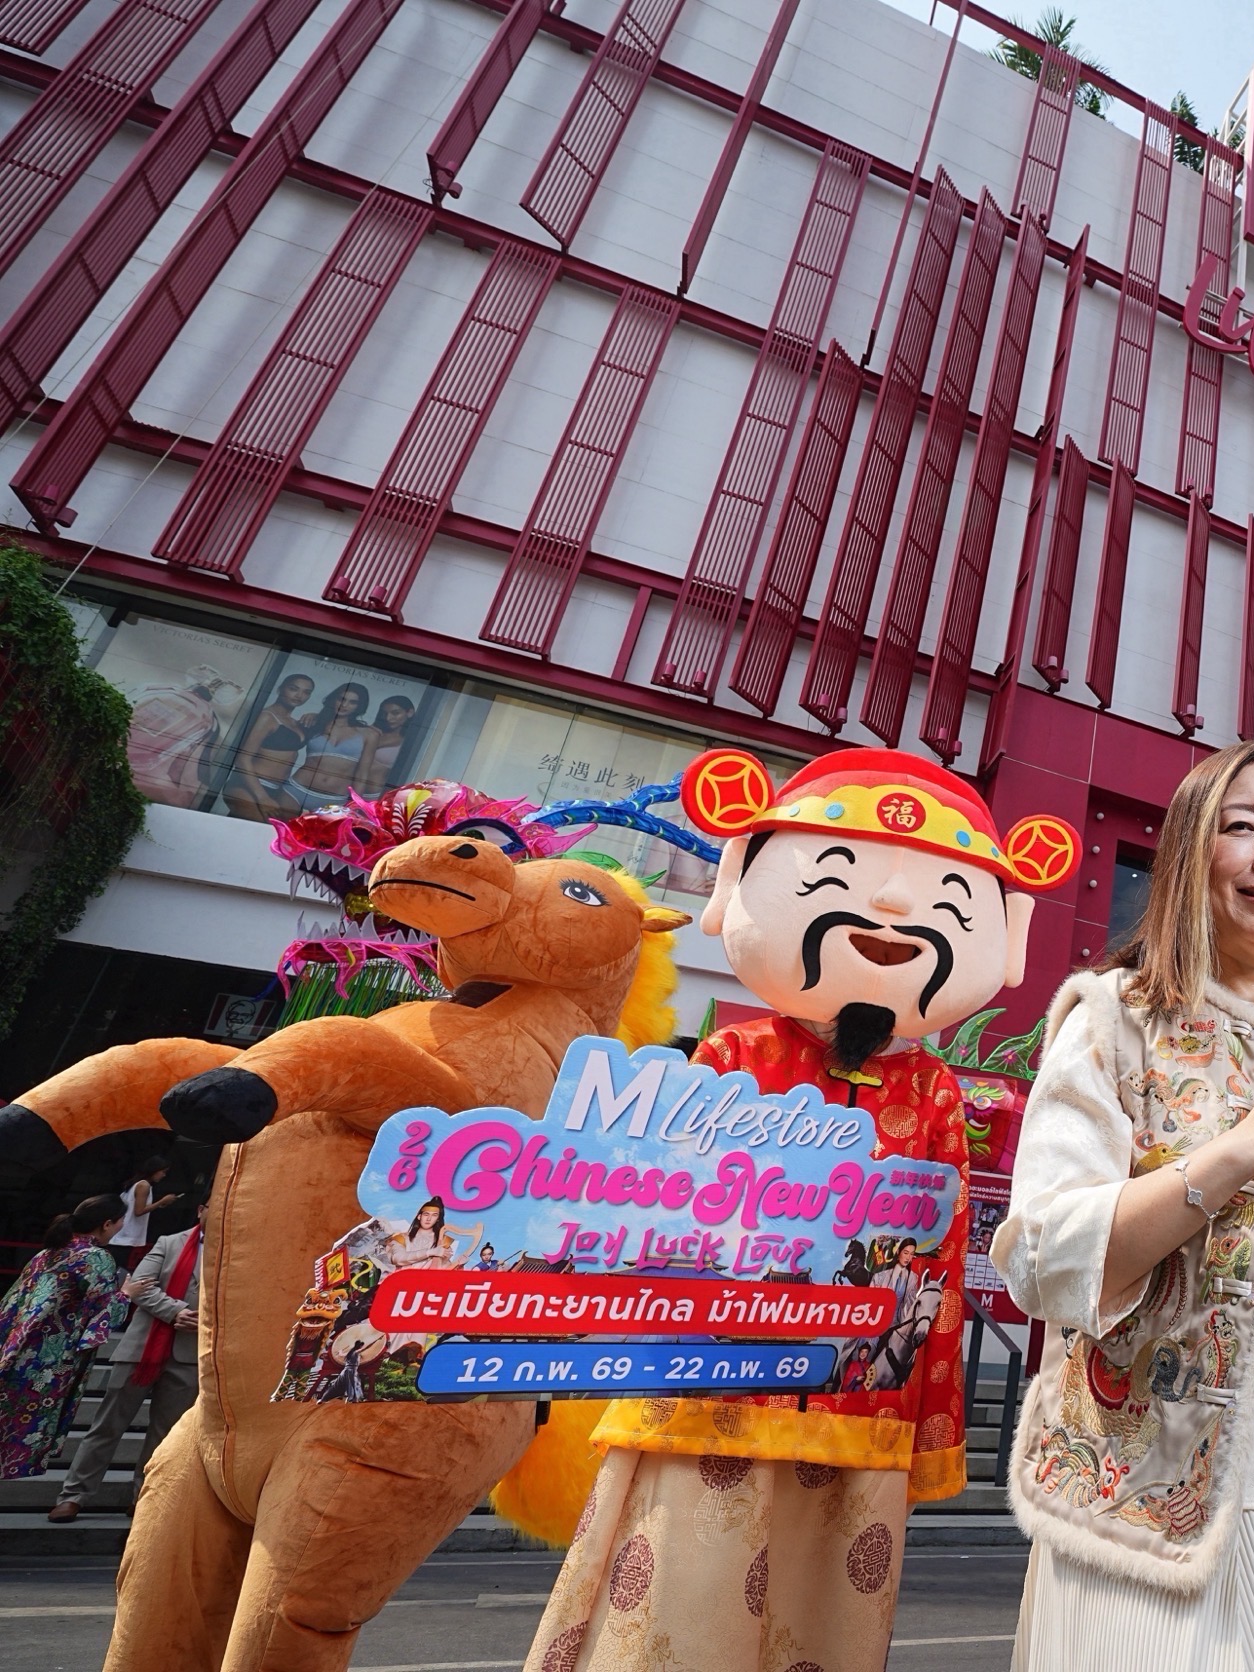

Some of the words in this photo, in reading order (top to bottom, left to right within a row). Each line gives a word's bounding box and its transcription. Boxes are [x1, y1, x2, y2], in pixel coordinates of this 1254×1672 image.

[881, 798, 917, 829] 福
[565, 1049, 668, 1138] M
[658, 1078, 862, 1154] Lifestore
[426, 1121, 694, 1212] Chinese
[692, 1151, 830, 1230] New
[828, 1161, 941, 1239] Year
[390, 1281, 695, 1323] มะเมียทะยานไกล
[707, 1288, 885, 1327] ม้าไฟมหาเฮง
[981, 1292, 994, 1308] M
[456, 1357, 504, 1383] 12
[512, 1360, 579, 1382] ก.พ.
[591, 1356, 632, 1381] 69
[664, 1356, 704, 1380] 22
[711, 1360, 765, 1379] ก.พ.
[775, 1356, 810, 1378] 69
